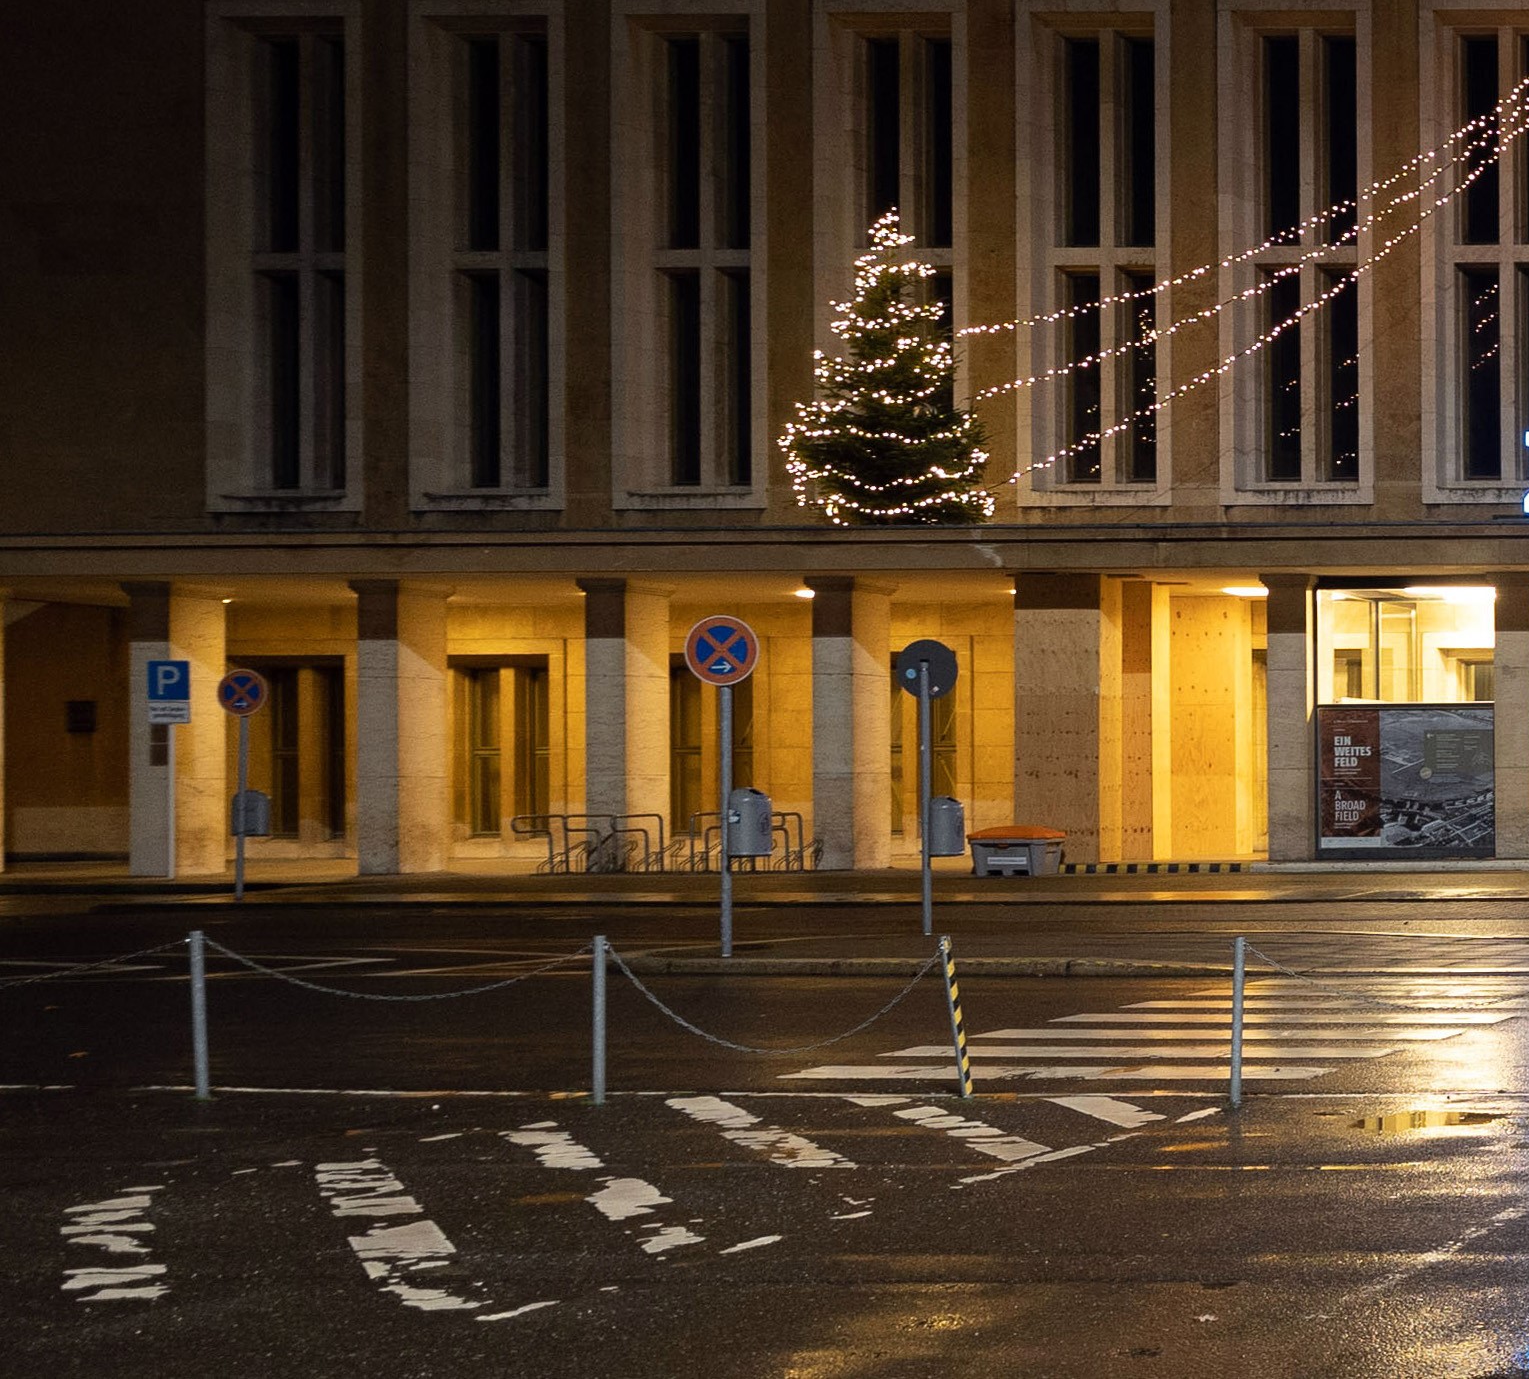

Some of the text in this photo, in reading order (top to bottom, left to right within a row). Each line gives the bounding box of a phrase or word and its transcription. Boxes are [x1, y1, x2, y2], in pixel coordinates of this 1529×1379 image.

[157, 665, 181, 695] P
[1334, 736, 1352, 746] EIN
[1333, 746, 1372, 757] WEITES
[1334, 757, 1358, 768] FELD
[1334, 790, 1342, 800] A
[1334, 800, 1366, 811] BROAD
[1334, 811, 1360, 822] FIELD
